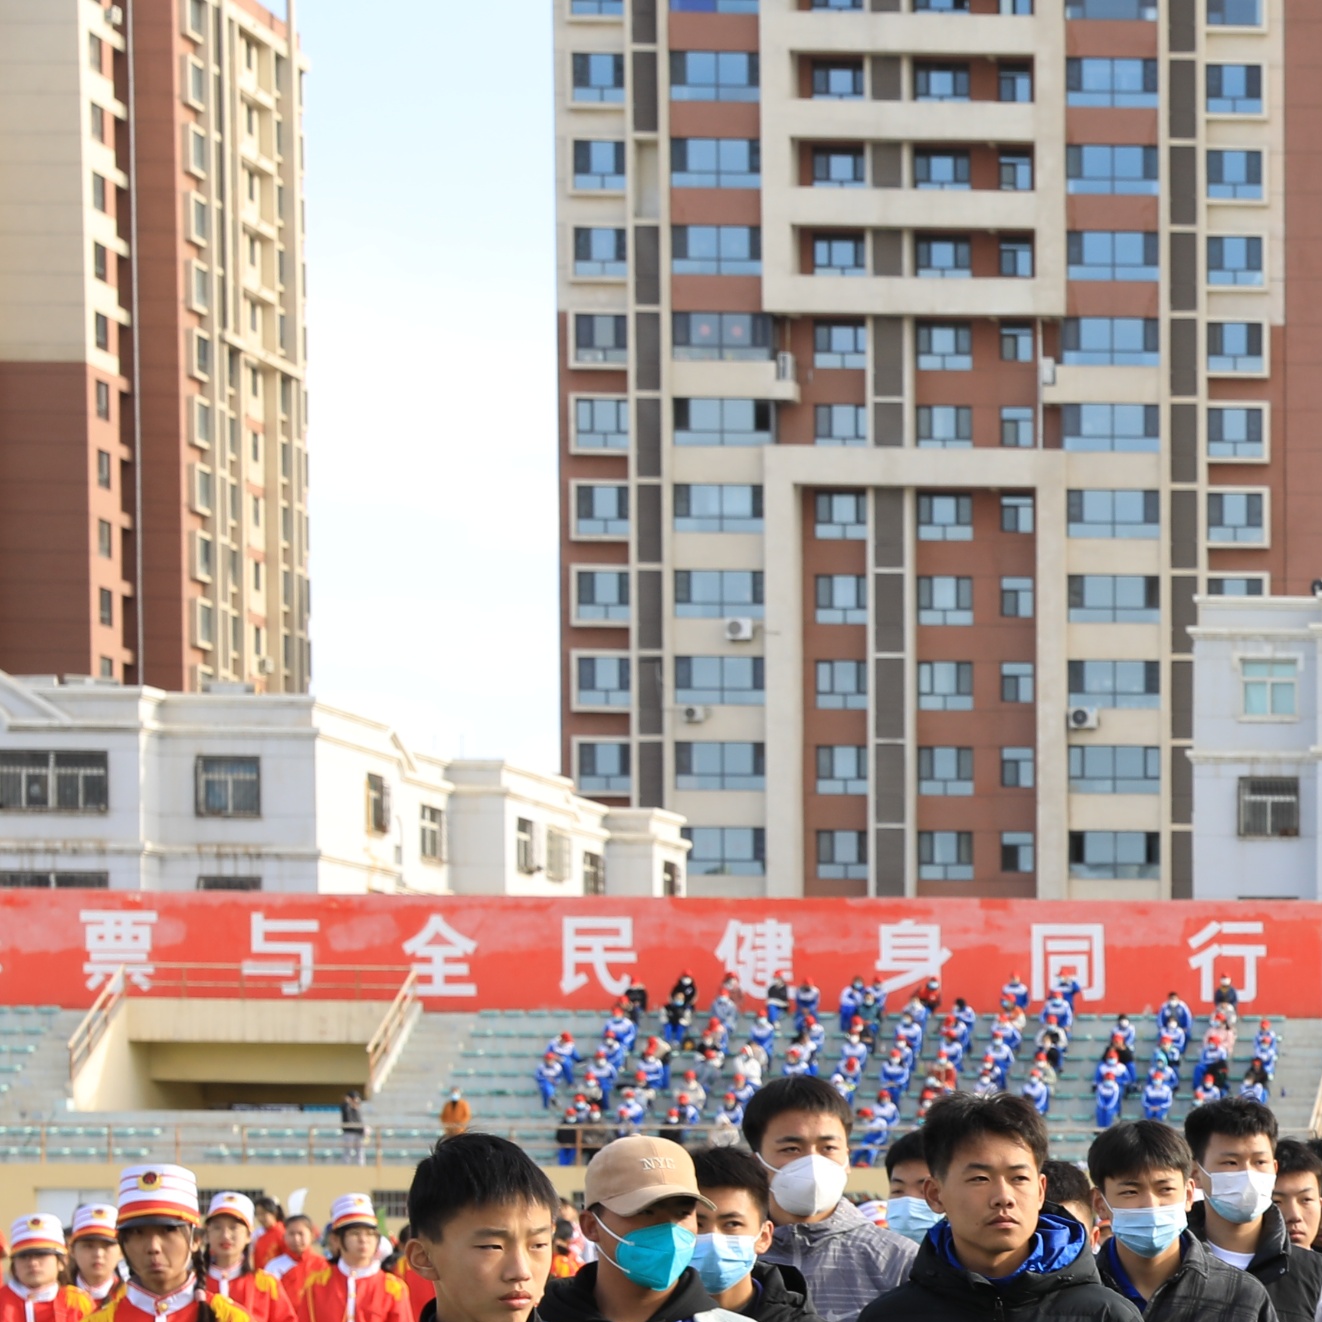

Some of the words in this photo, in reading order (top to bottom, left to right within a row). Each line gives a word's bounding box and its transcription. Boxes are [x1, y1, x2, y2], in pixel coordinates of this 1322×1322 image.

[79, 909, 1267, 1003] 票与全民健身同行
